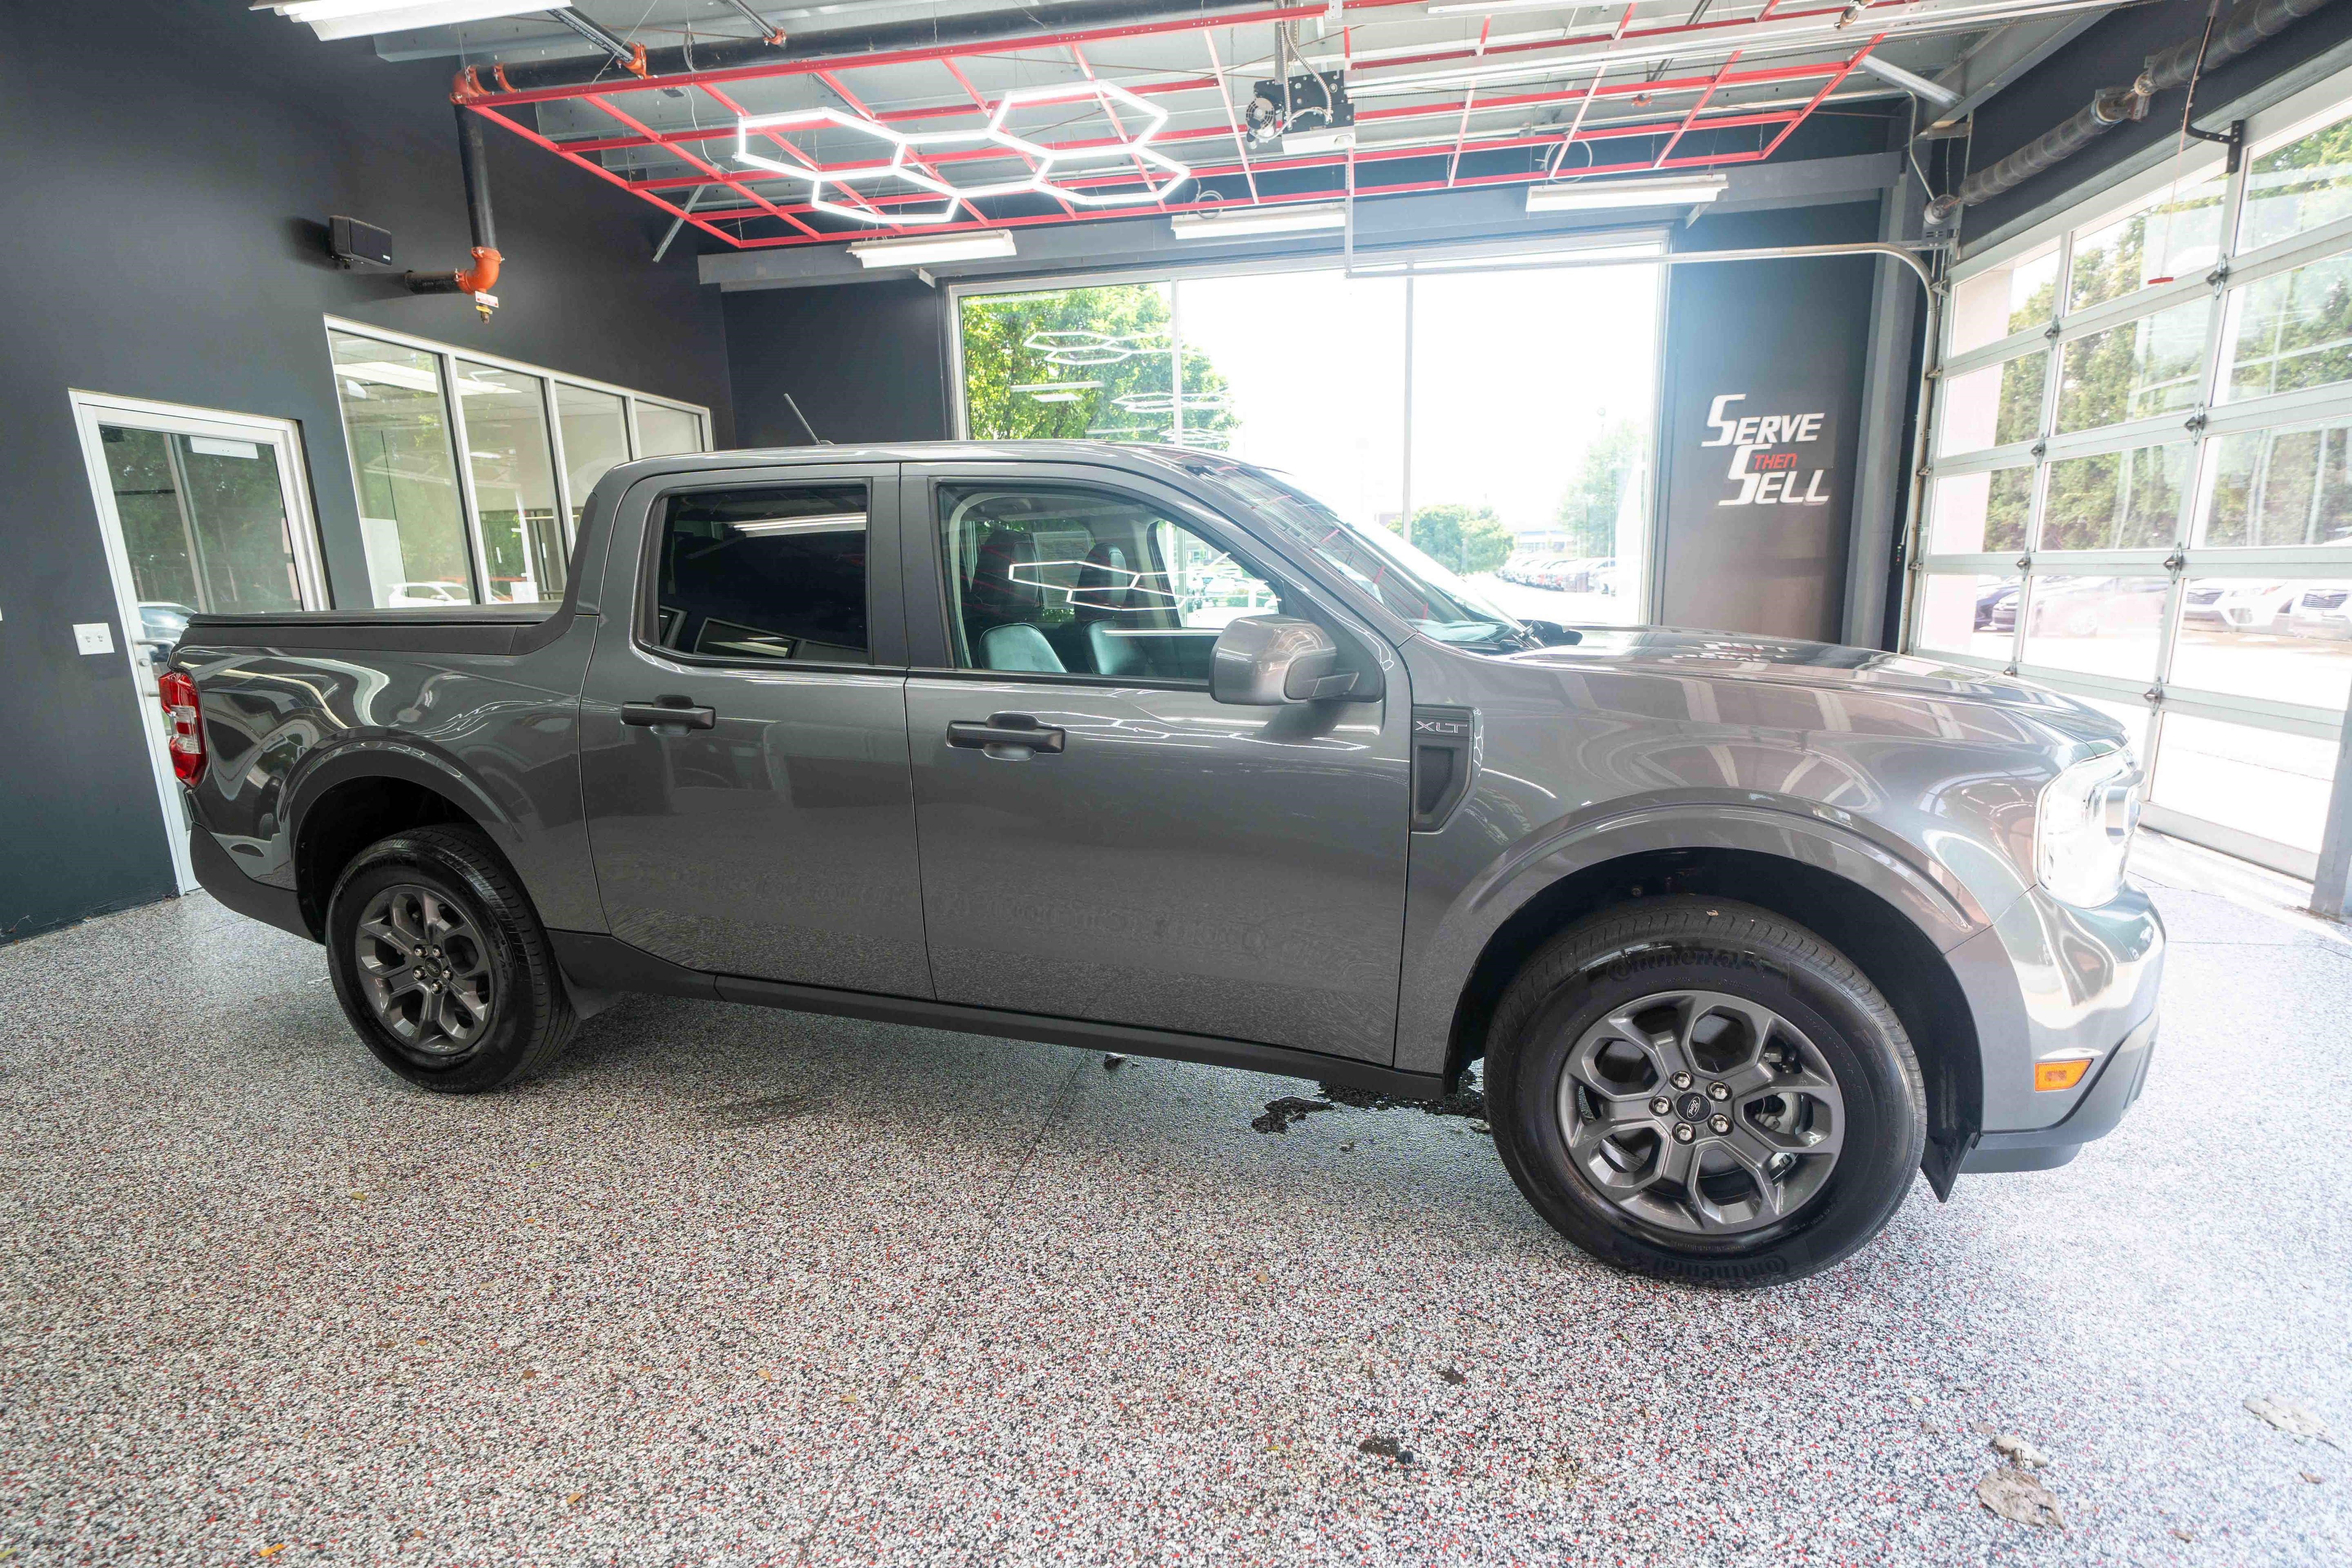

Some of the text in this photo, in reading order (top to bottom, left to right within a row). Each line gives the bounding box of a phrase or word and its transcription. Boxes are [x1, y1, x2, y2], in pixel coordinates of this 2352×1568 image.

[1701, 393, 1825, 448] SERVE
[1718, 443, 1830, 506] SELL
[1415, 721, 1467, 733] XLT
[1688, 1098, 1700, 1116] Ford
